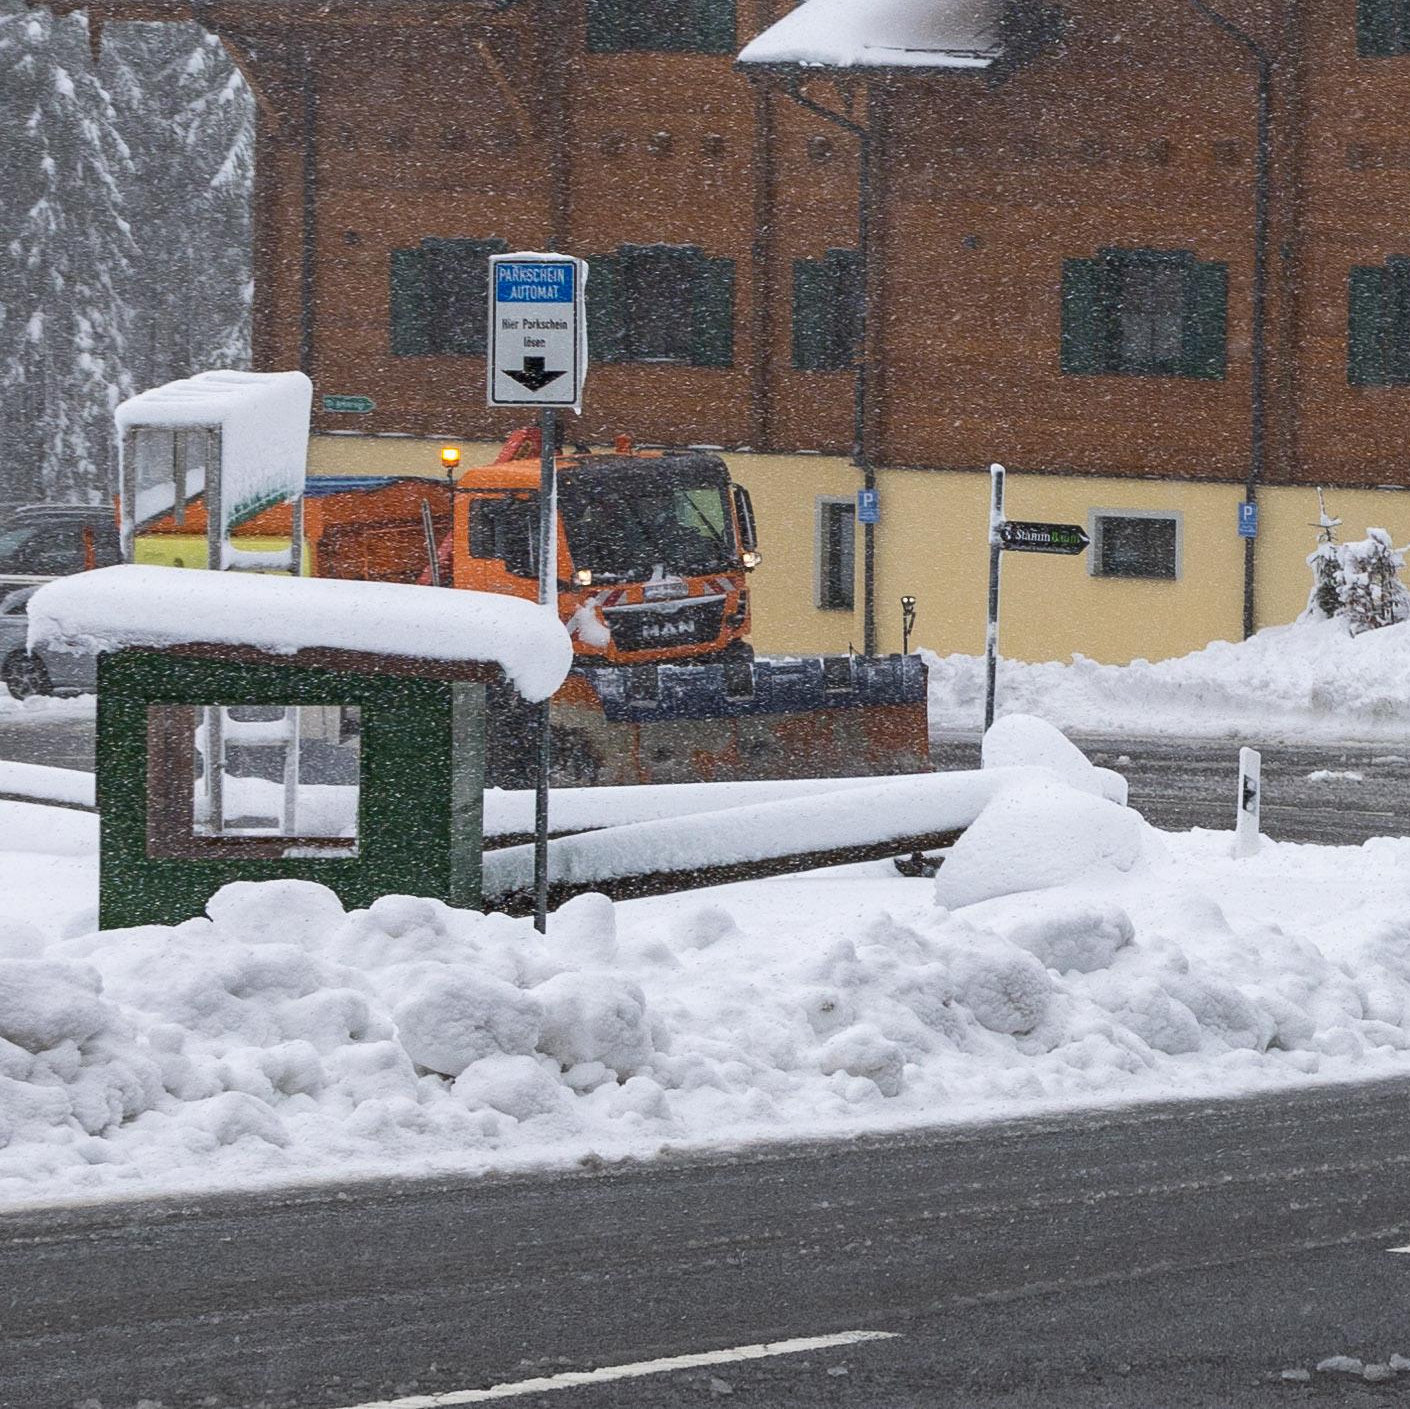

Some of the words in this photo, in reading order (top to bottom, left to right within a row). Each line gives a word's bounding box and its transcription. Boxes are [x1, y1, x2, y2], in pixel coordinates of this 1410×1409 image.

[500, 267, 565, 284] PARKSCHEIN
[512, 285, 559, 300] AUTOMAT
[502, 318, 519, 329] Hier
[522, 318, 568, 329] Parkschein
[523, 336, 546, 347] lösen
[863, 493, 873, 507] P
[1244, 506, 1252, 520] P
[642, 620, 695, 638] MAN
